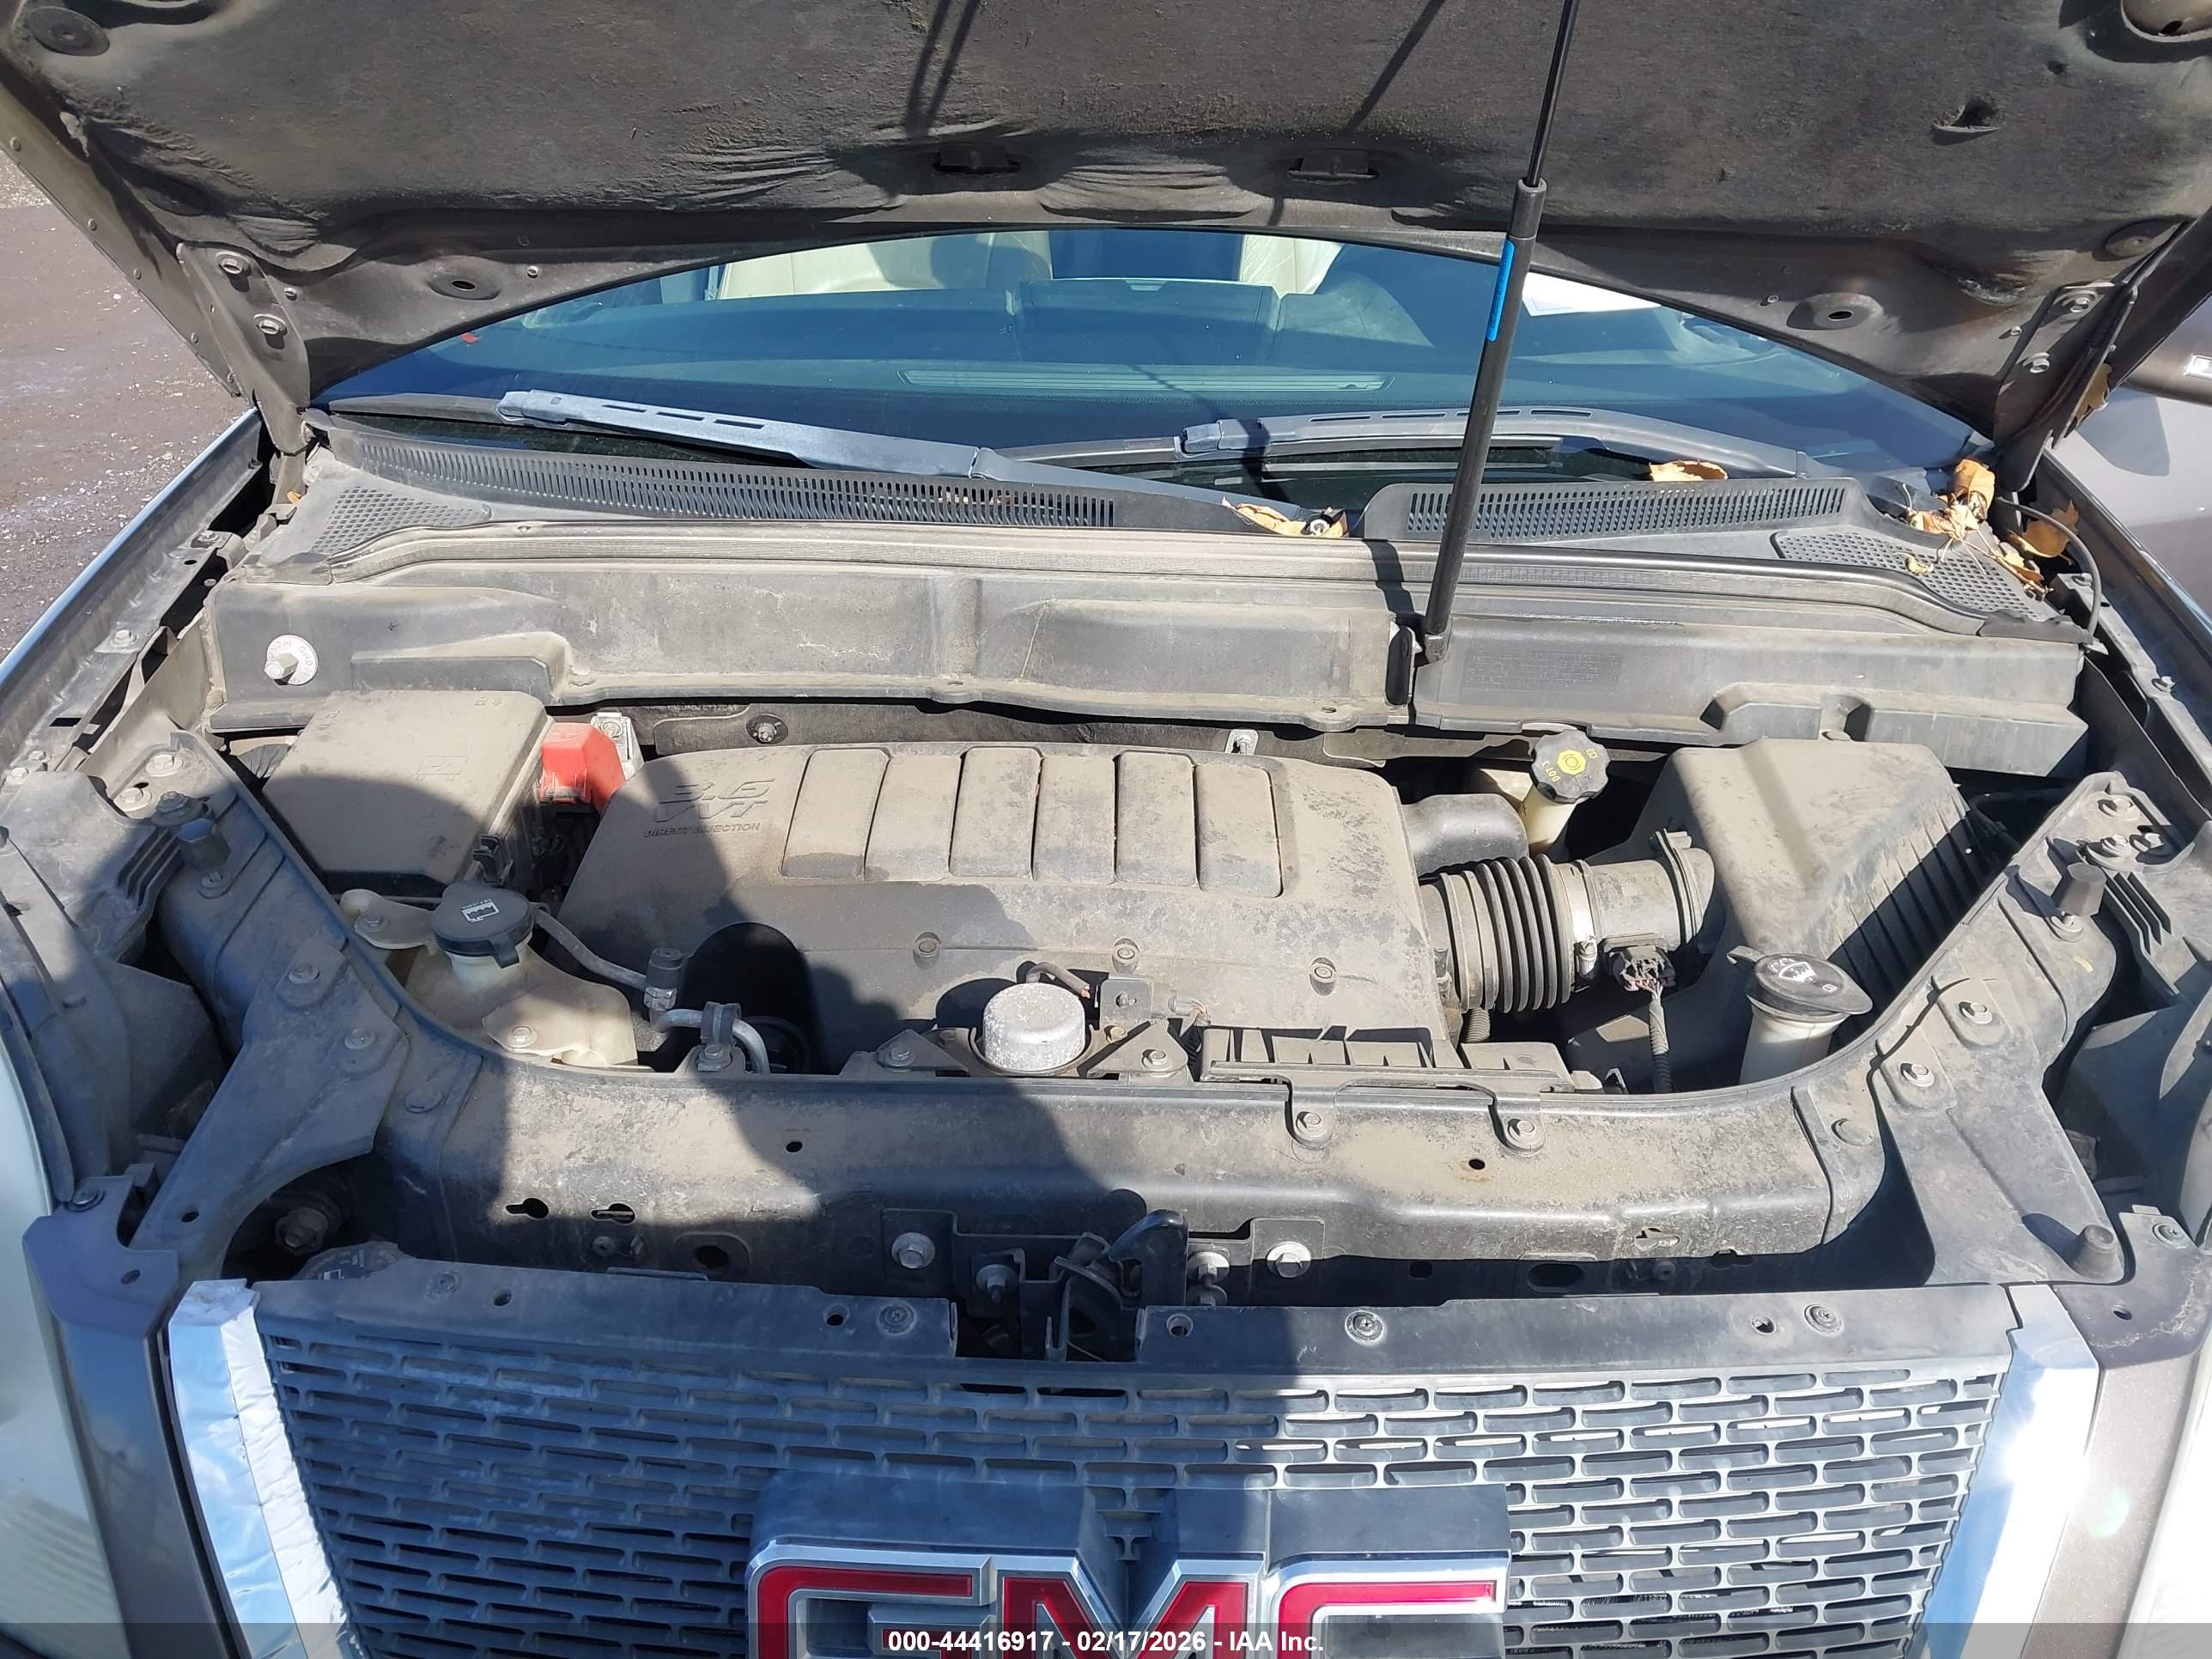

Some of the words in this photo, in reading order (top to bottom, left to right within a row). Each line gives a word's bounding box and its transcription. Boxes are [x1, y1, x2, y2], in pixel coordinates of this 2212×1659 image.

[1545, 768, 1560, 782] DOT
[659, 778, 775, 804] 3.6
[655, 800, 769, 823] VVT
[691, 822, 762, 836] INJECTION
[744, 1543, 1511, 1659] GMC
